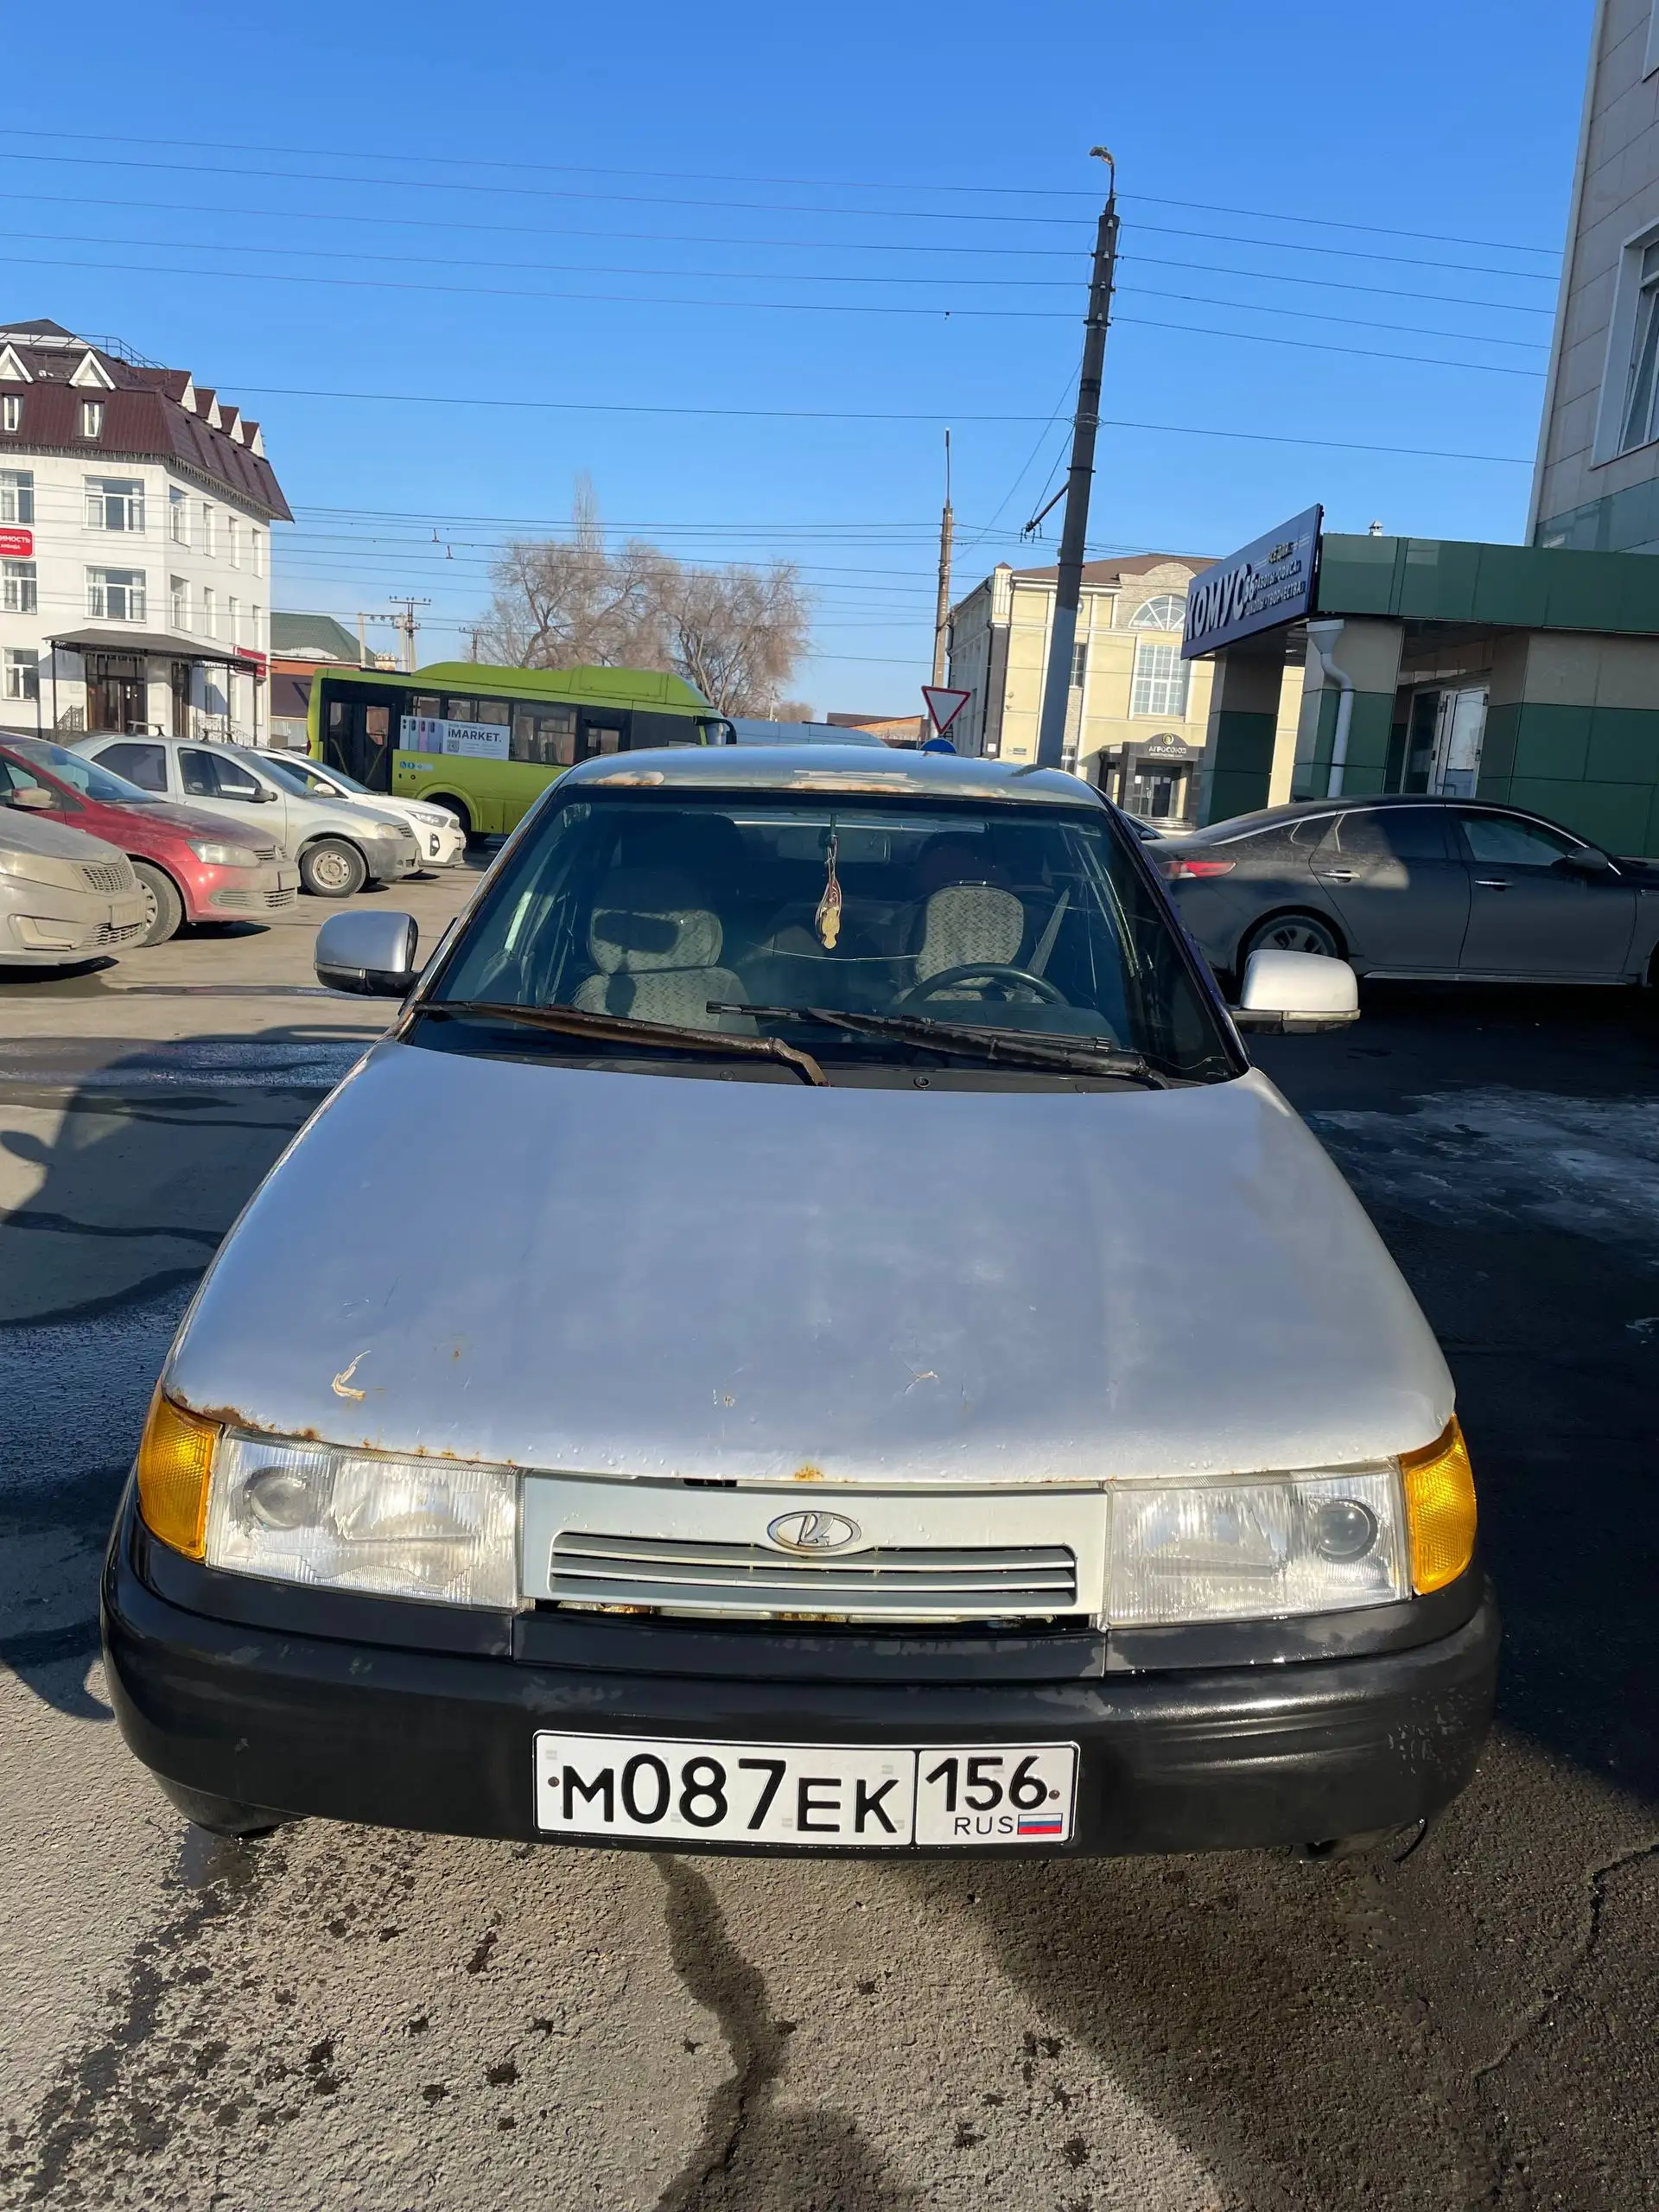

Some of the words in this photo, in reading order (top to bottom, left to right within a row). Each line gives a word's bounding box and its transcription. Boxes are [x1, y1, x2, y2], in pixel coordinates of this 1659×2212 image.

[1184, 563, 1248, 642] КОМУС
[1243, 573, 1257, 603] 56
[1148, 746, 1187, 754] АГРОСОЮЗ
[925, 1756, 1047, 1812] 156
[953, 1816, 1014, 1835] RUS
